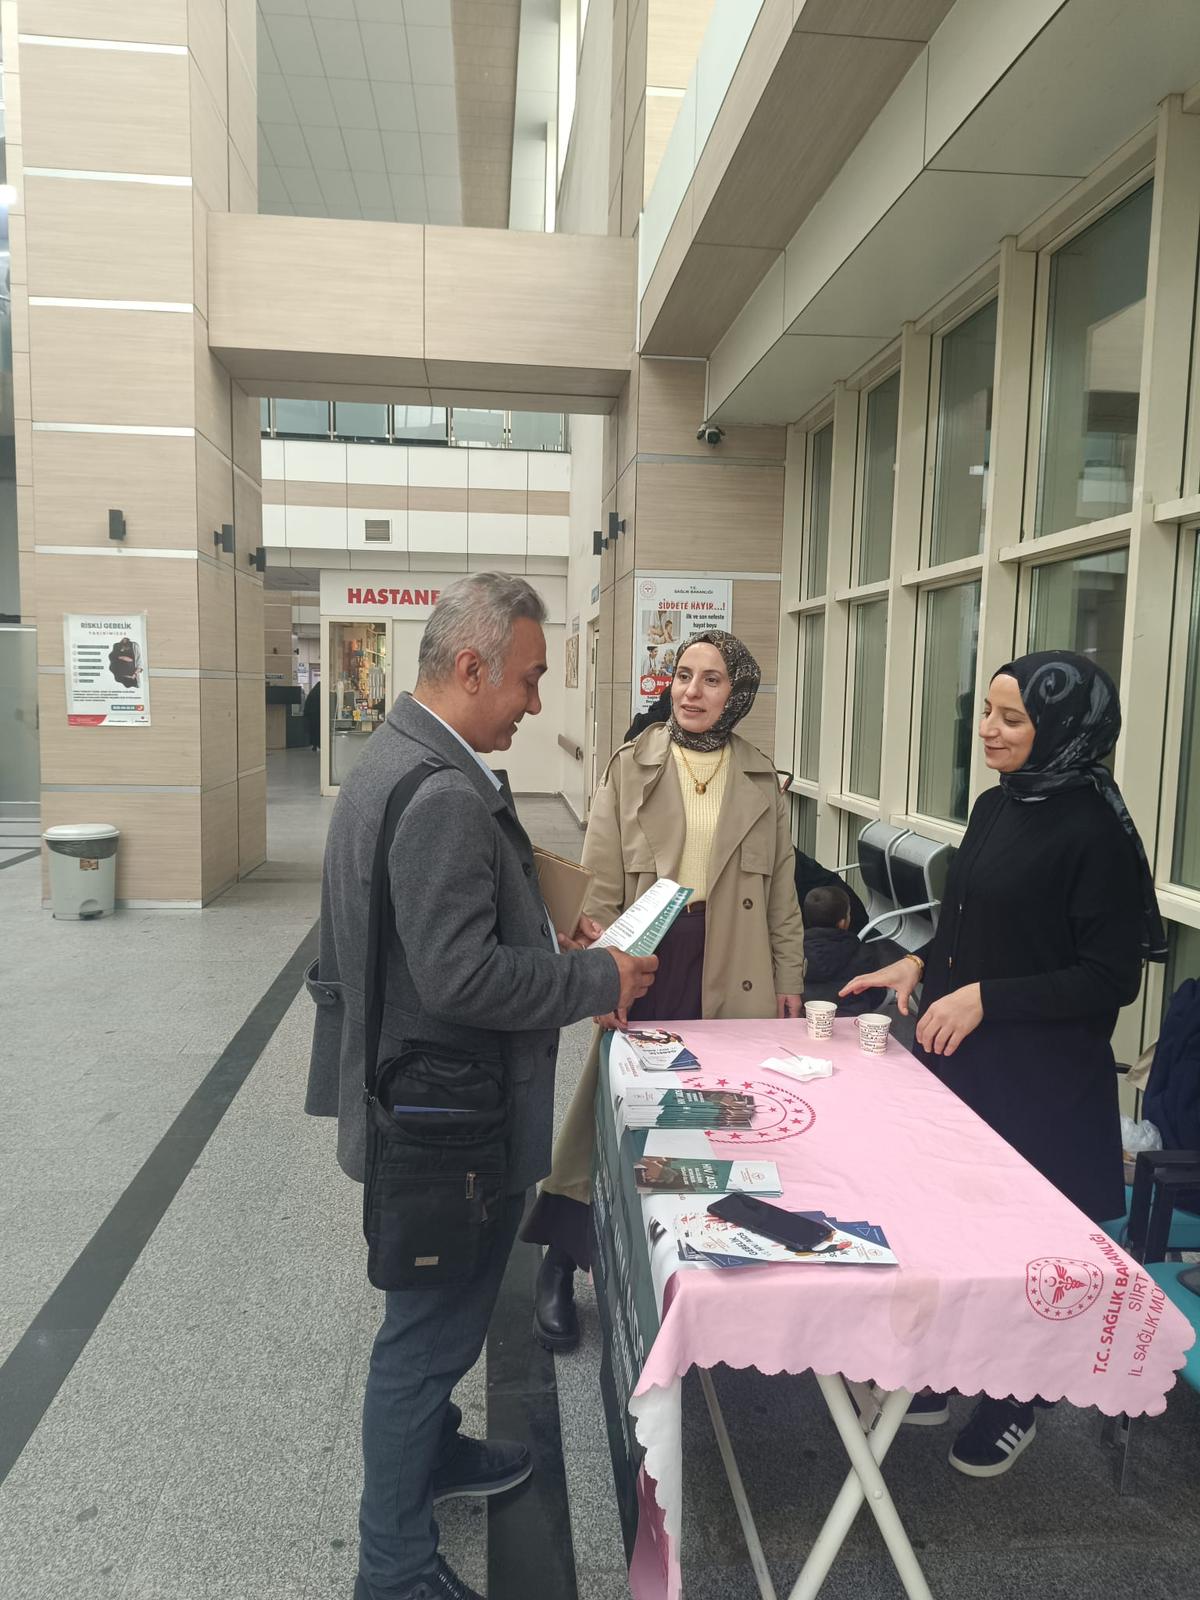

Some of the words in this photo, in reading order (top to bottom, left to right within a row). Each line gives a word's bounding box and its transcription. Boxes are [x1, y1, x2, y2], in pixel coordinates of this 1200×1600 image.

[1089, 1233, 1130, 1287] BAKANLIĞI
[1100, 1290, 1126, 1345] SAĞLIK
[1133, 1312, 1161, 1362] SAĞLIK
[1127, 1365, 1144, 1377] İL
